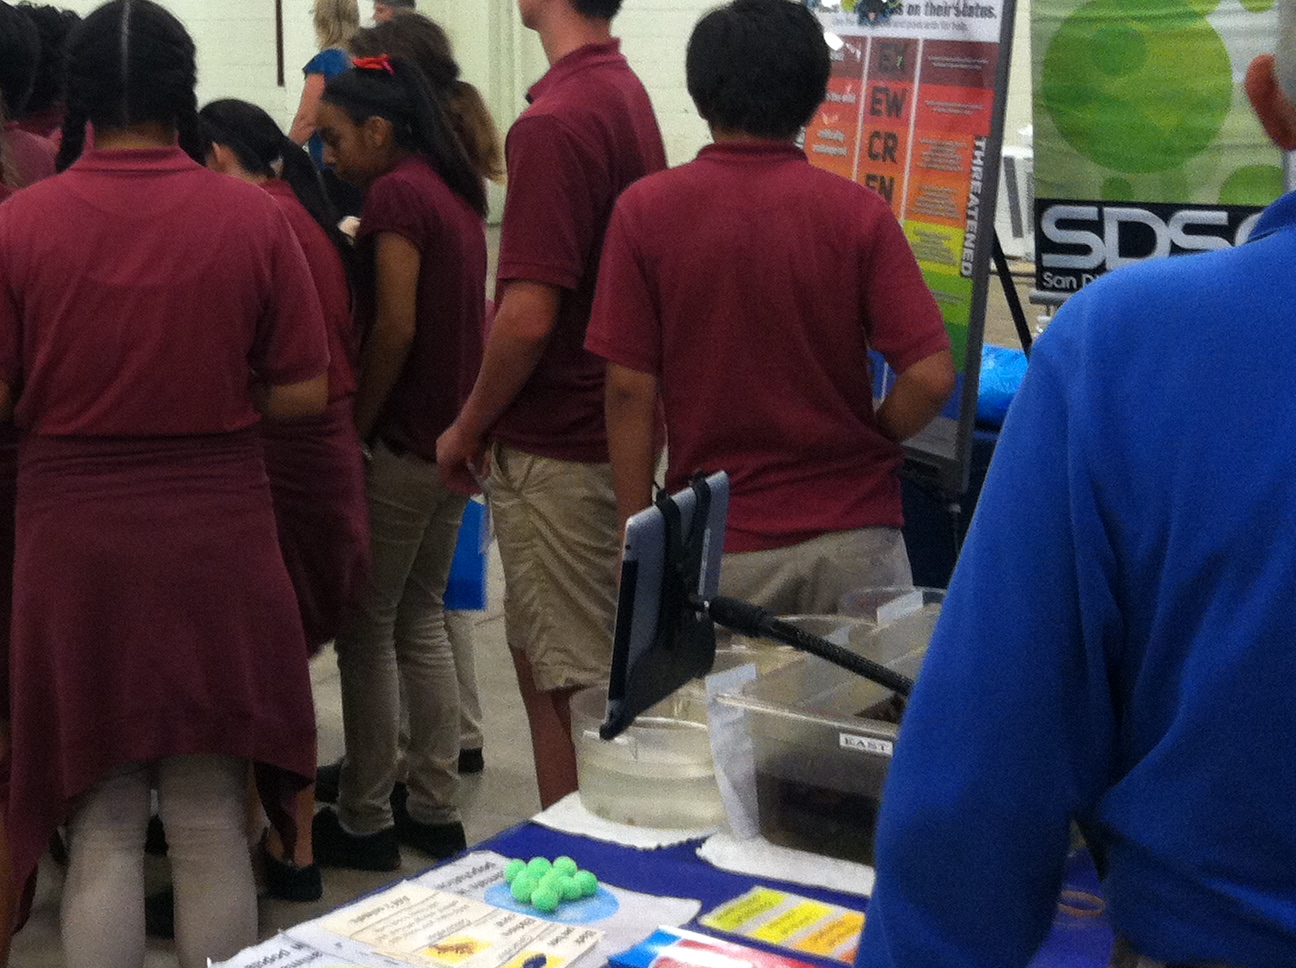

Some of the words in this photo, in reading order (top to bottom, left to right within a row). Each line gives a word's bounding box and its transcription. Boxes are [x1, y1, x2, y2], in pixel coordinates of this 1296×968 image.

[907, 4, 922, 17] on
[923, 2, 953, 18] their
[869, 85, 908, 119] EW
[867, 131, 899, 164] CR
[960, 135, 988, 277] THREATENED
[1041, 271, 1078, 290] San
[844, 736, 891, 752] EAST
